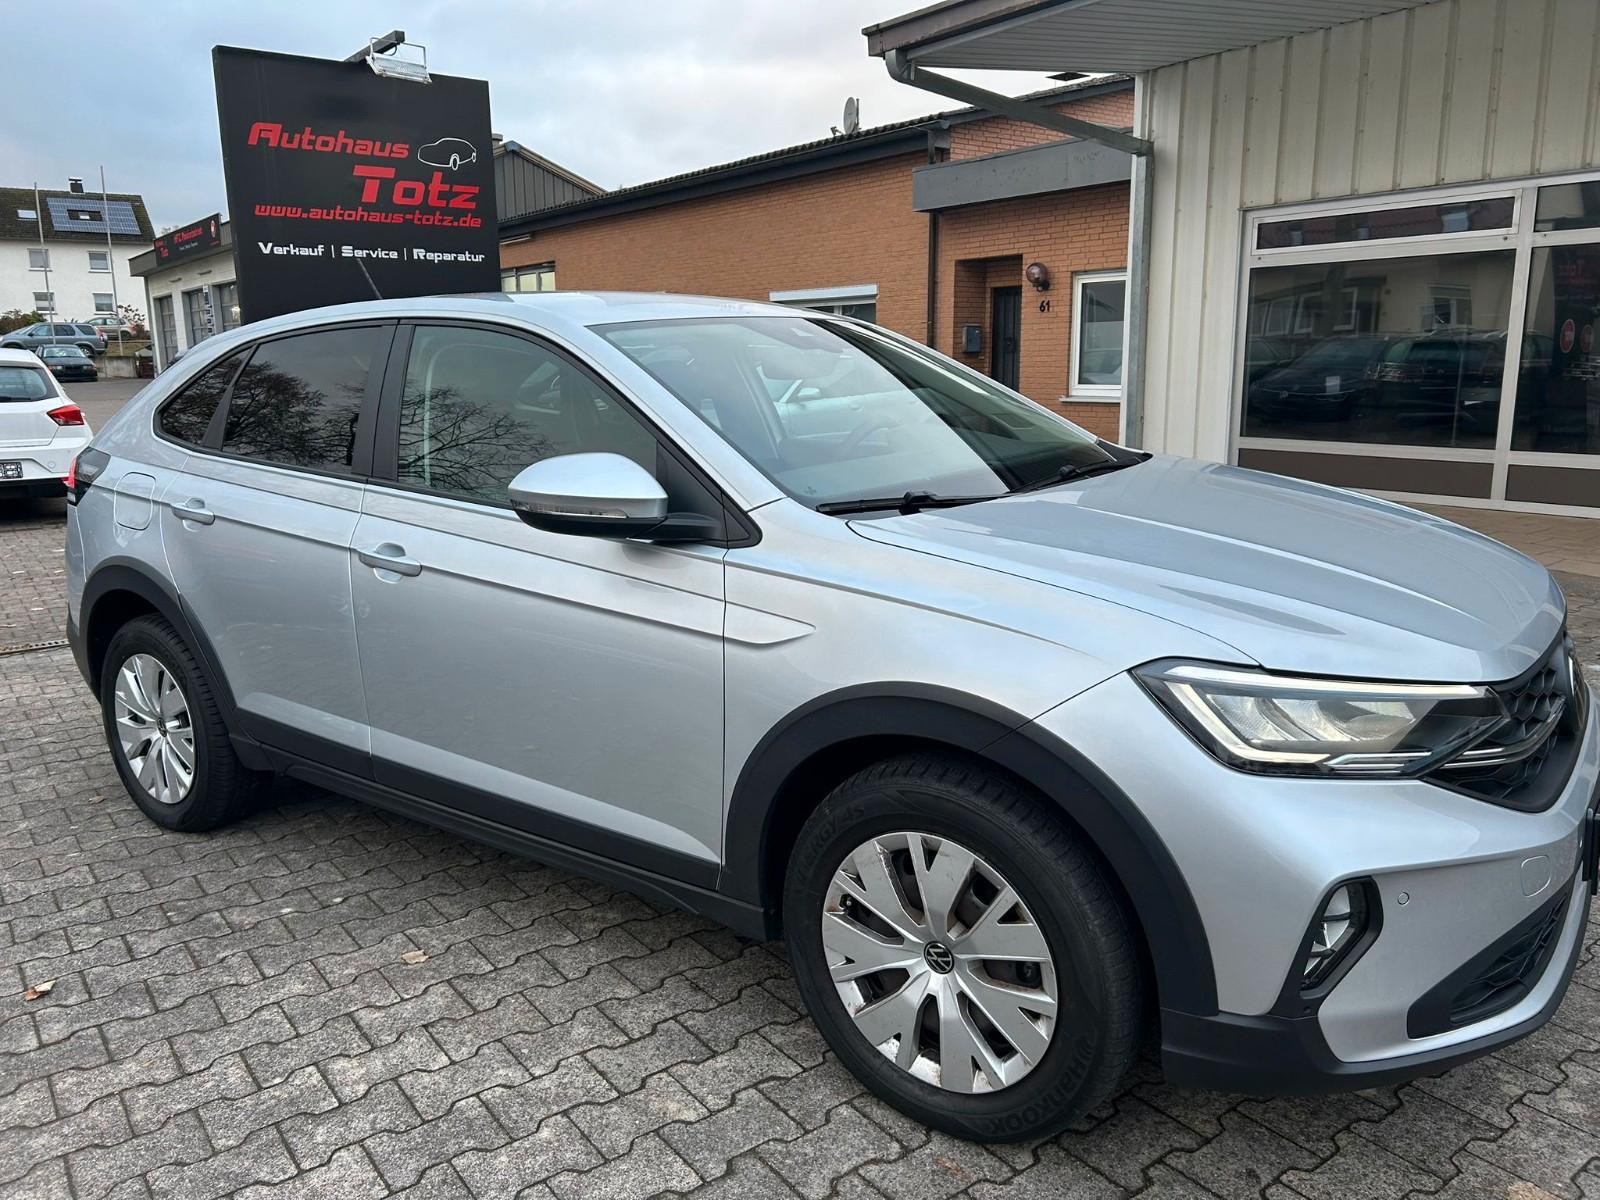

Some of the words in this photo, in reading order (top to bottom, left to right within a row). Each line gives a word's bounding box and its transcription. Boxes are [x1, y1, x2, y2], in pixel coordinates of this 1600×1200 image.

[247, 121, 410, 158] Autohaus
[352, 164, 480, 209] Totz
[254, 204, 482, 228] www.autohaus-totz.de
[257, 241, 325, 256] Verkauf
[341, 245, 399, 259] Service
[412, 248, 486, 263] Reparatur
[1039, 299, 1051, 313] 61
